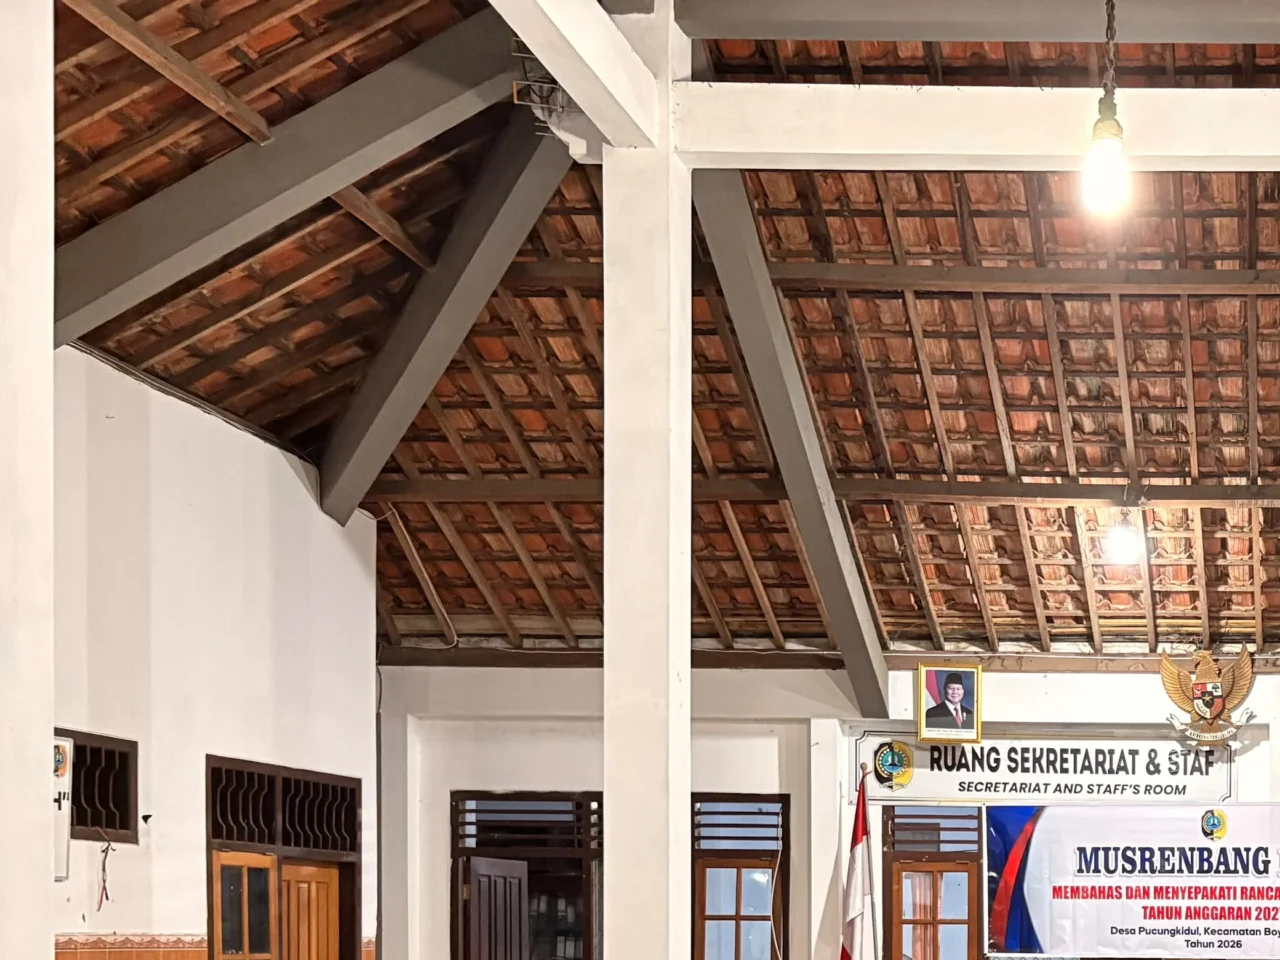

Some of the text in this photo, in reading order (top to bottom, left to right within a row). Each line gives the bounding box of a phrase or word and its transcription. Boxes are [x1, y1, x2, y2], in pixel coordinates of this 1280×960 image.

[930, 745, 1215, 776] RUANG SEKRETARIAT & STAF
[958, 781, 1187, 795] SECRETARIAT AND STAFF'S ROOM
[1076, 846, 1271, 875] MUSRENBANG
[1052, 885, 1122, 900] MEMBAHAS
[1125, 885, 1150, 900] DAN
[1153, 886, 1237, 901] MENYEPAKATI
[1142, 905, 1182, 920] TAHUN
[1185, 906, 1251, 921] ANGGARAN
[1110, 926, 1136, 935] Desa
[1138, 926, 1201, 938] Pucungkidul,
[1203, 926, 1261, 936] Kecamatan
[1184, 939, 1243, 948] Tahun 2026
